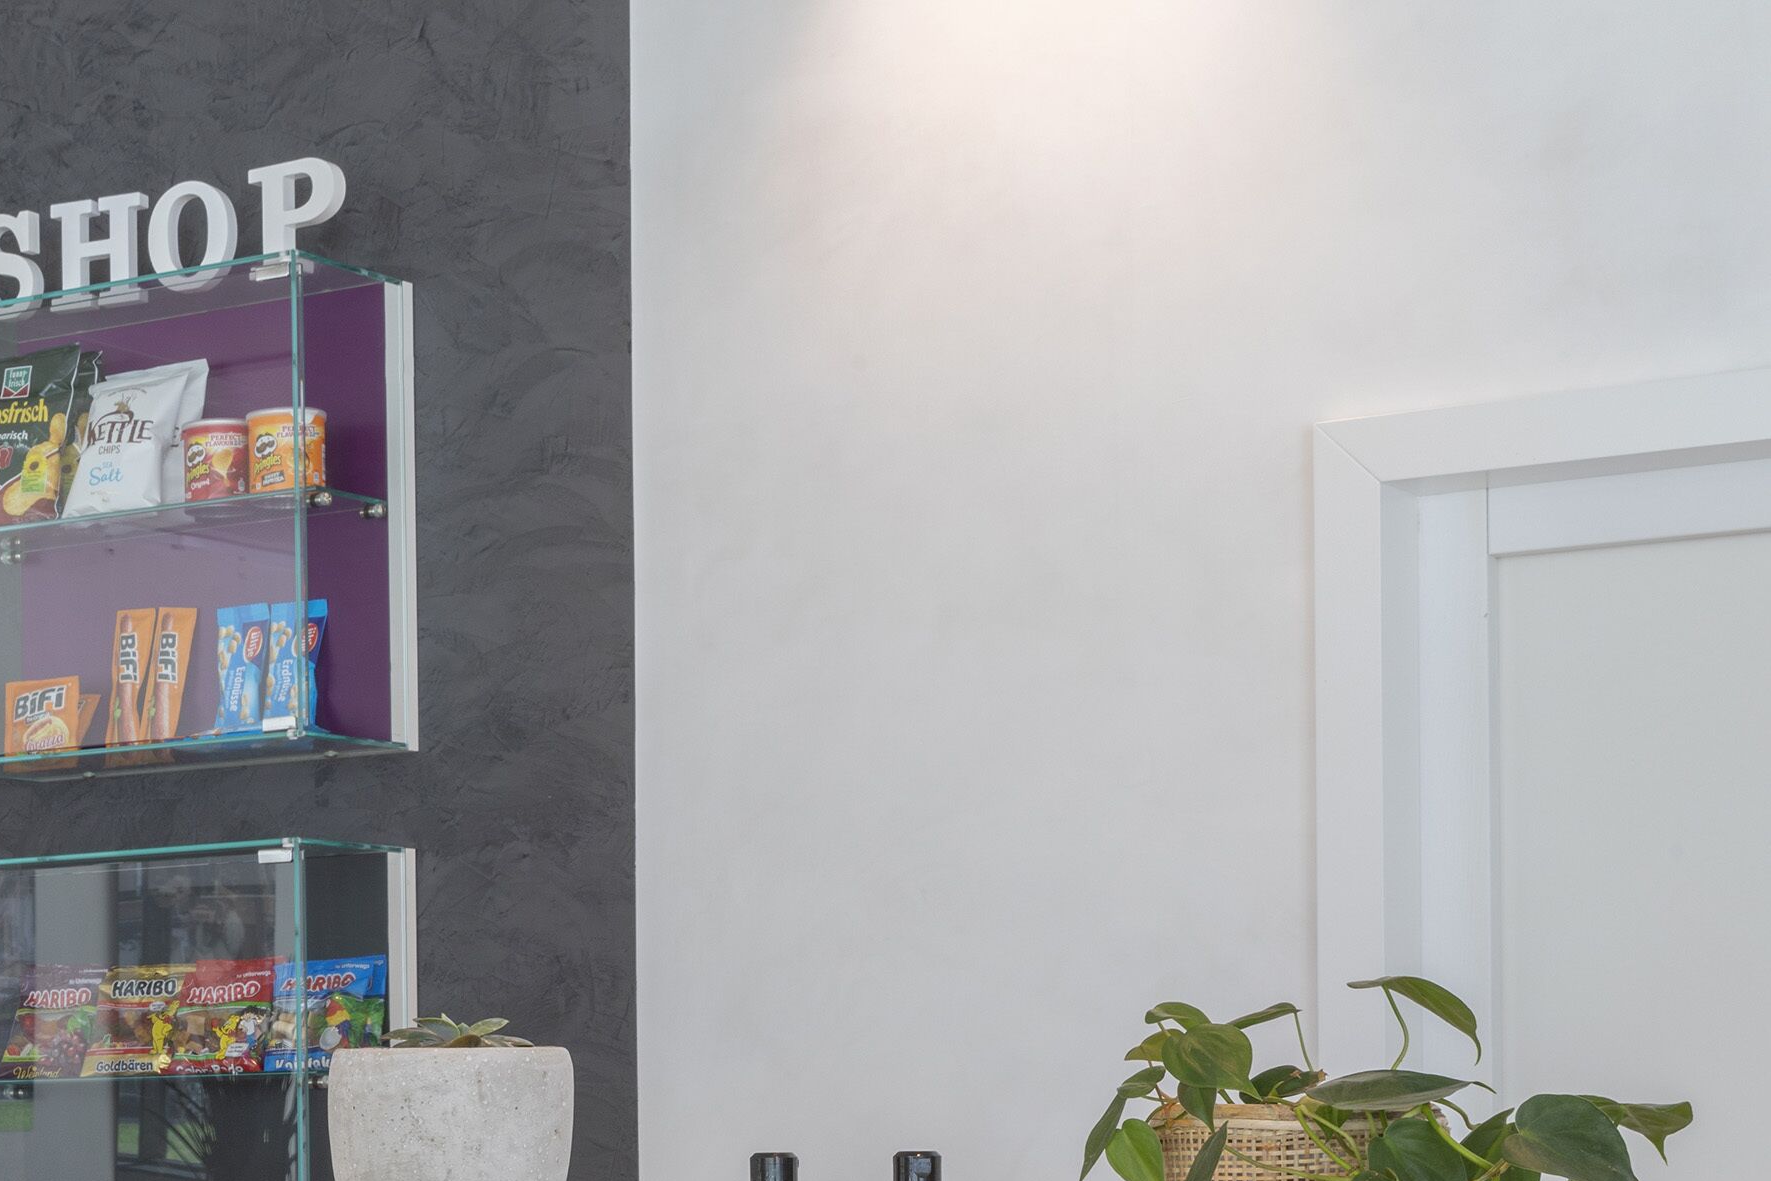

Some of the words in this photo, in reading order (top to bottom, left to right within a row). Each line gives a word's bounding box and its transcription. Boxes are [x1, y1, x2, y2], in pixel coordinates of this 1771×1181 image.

[87, 418, 154, 446] KETTLE
[98, 445, 121, 455] CHIPS
[89, 466, 122, 486] Salt
[230, 665, 246, 712] Erdnüsse
[23, 987, 92, 1008] HARIBO
[111, 979, 178, 998] HARIBO
[186, 980, 261, 1004] HARIBO
[96, 1059, 153, 1073] Goldbären
